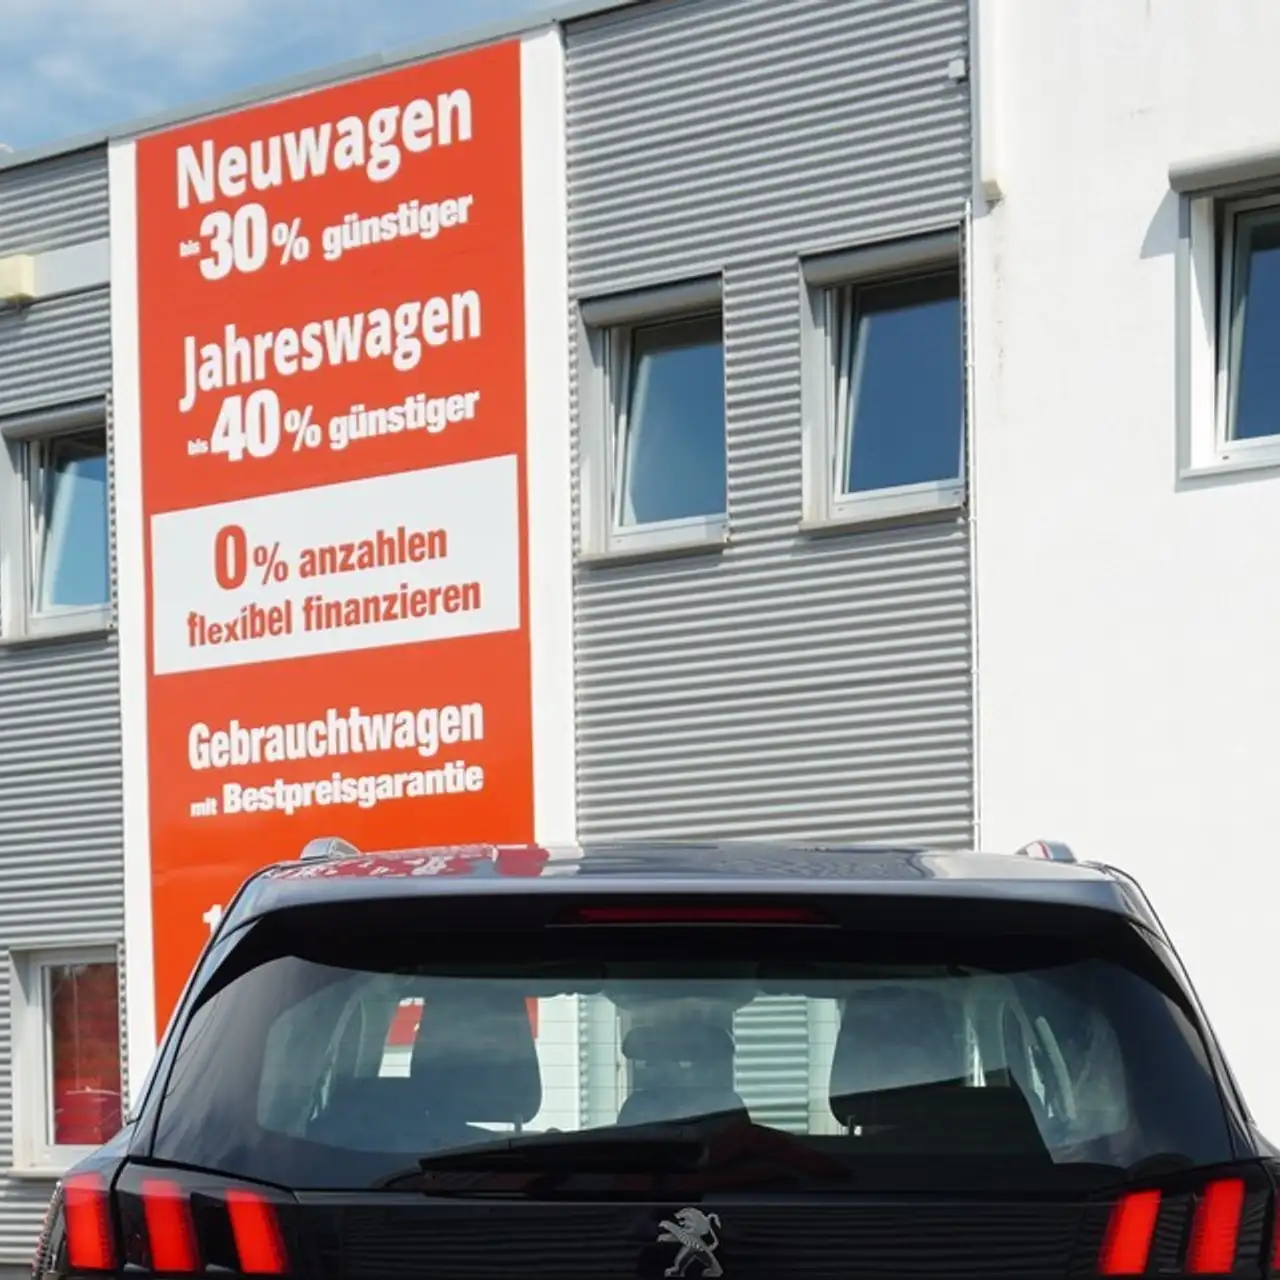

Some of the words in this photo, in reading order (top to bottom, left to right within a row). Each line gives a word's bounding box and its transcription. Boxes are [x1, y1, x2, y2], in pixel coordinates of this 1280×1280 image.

[176, 87, 473, 209] Neuwagen
[179, 239, 200, 258] bis
[322, 194, 473, 260] günstiger
[179, 288, 481, 412] Jahreswagen
[187, 438, 209, 456] bis
[328, 391, 480, 450] günstiger
[299, 526, 447, 579] anzahlen
[187, 599, 293, 647] flexibel
[303, 581, 481, 631] finanzieren
[189, 702, 483, 769] Gebrauchtwagen
[190, 798, 217, 817] mit
[223, 760, 483, 814] Bestpreisgarantie
